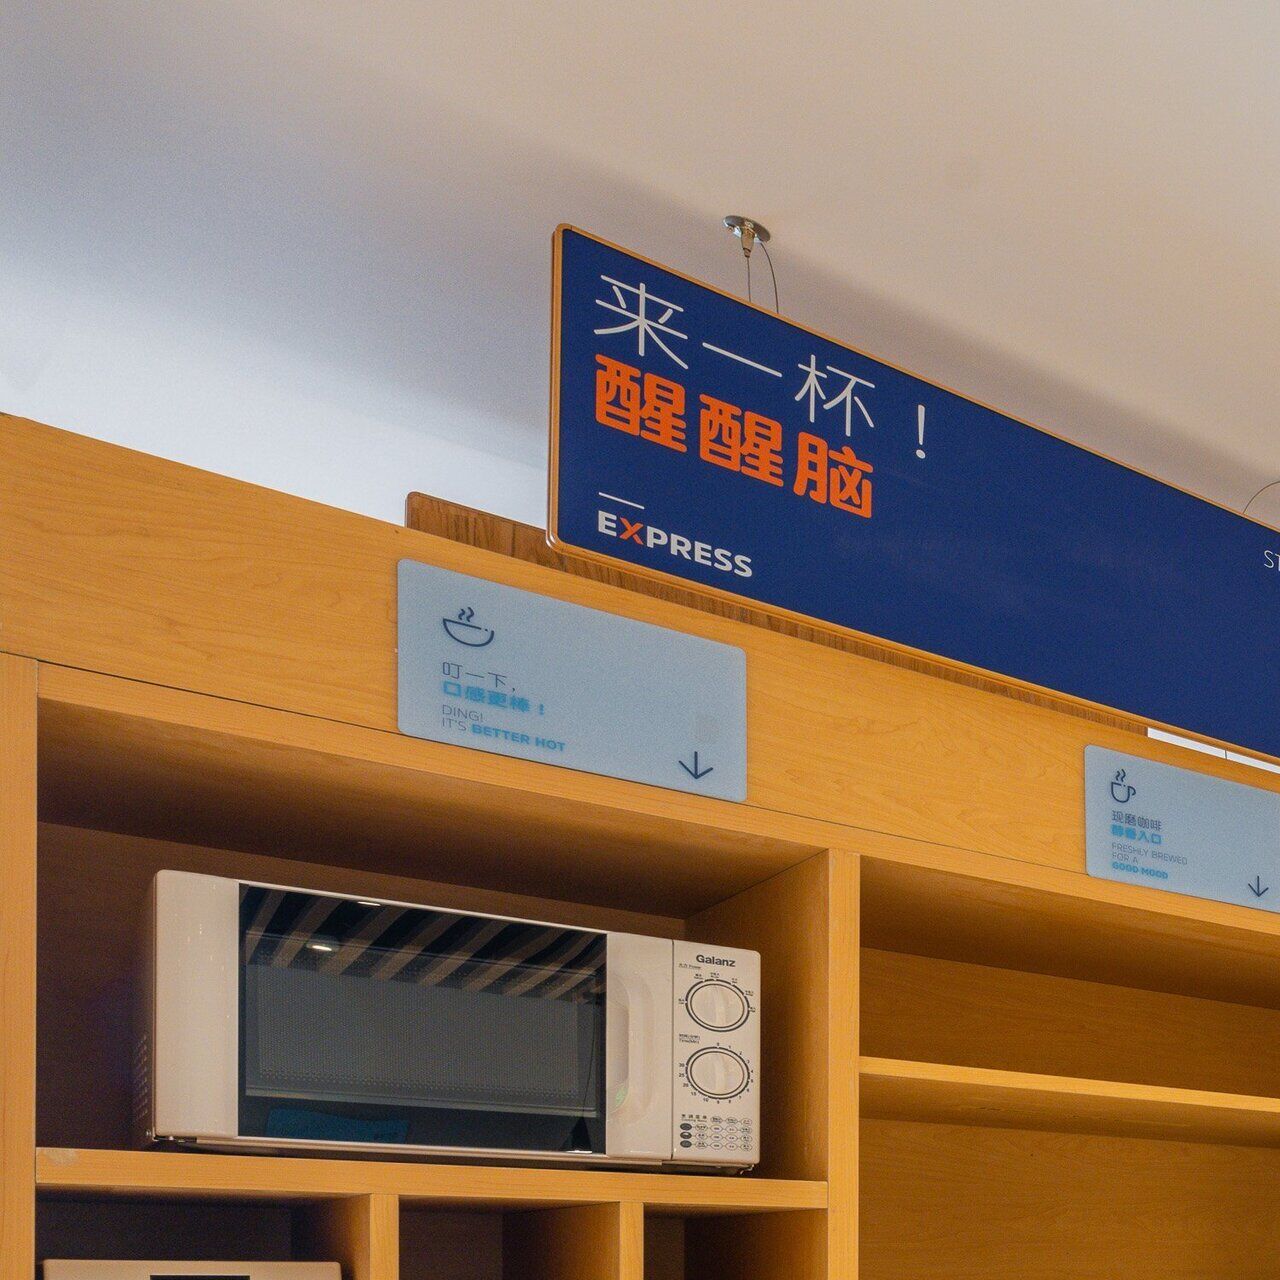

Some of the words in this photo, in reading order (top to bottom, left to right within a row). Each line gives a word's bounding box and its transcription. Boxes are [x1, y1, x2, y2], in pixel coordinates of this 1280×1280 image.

[594, 353, 874, 520] 醒醒脑
[598, 510, 754, 579] EXPRESS
[441, 716, 468, 733] IT'S
[470, 723, 531, 746] BETTER
[534, 736, 566, 753] HOT
[1111, 861, 1139, 874] GOOD
[1141, 867, 1168, 879] MOOD
[695, 953, 736, 968] Galanz
